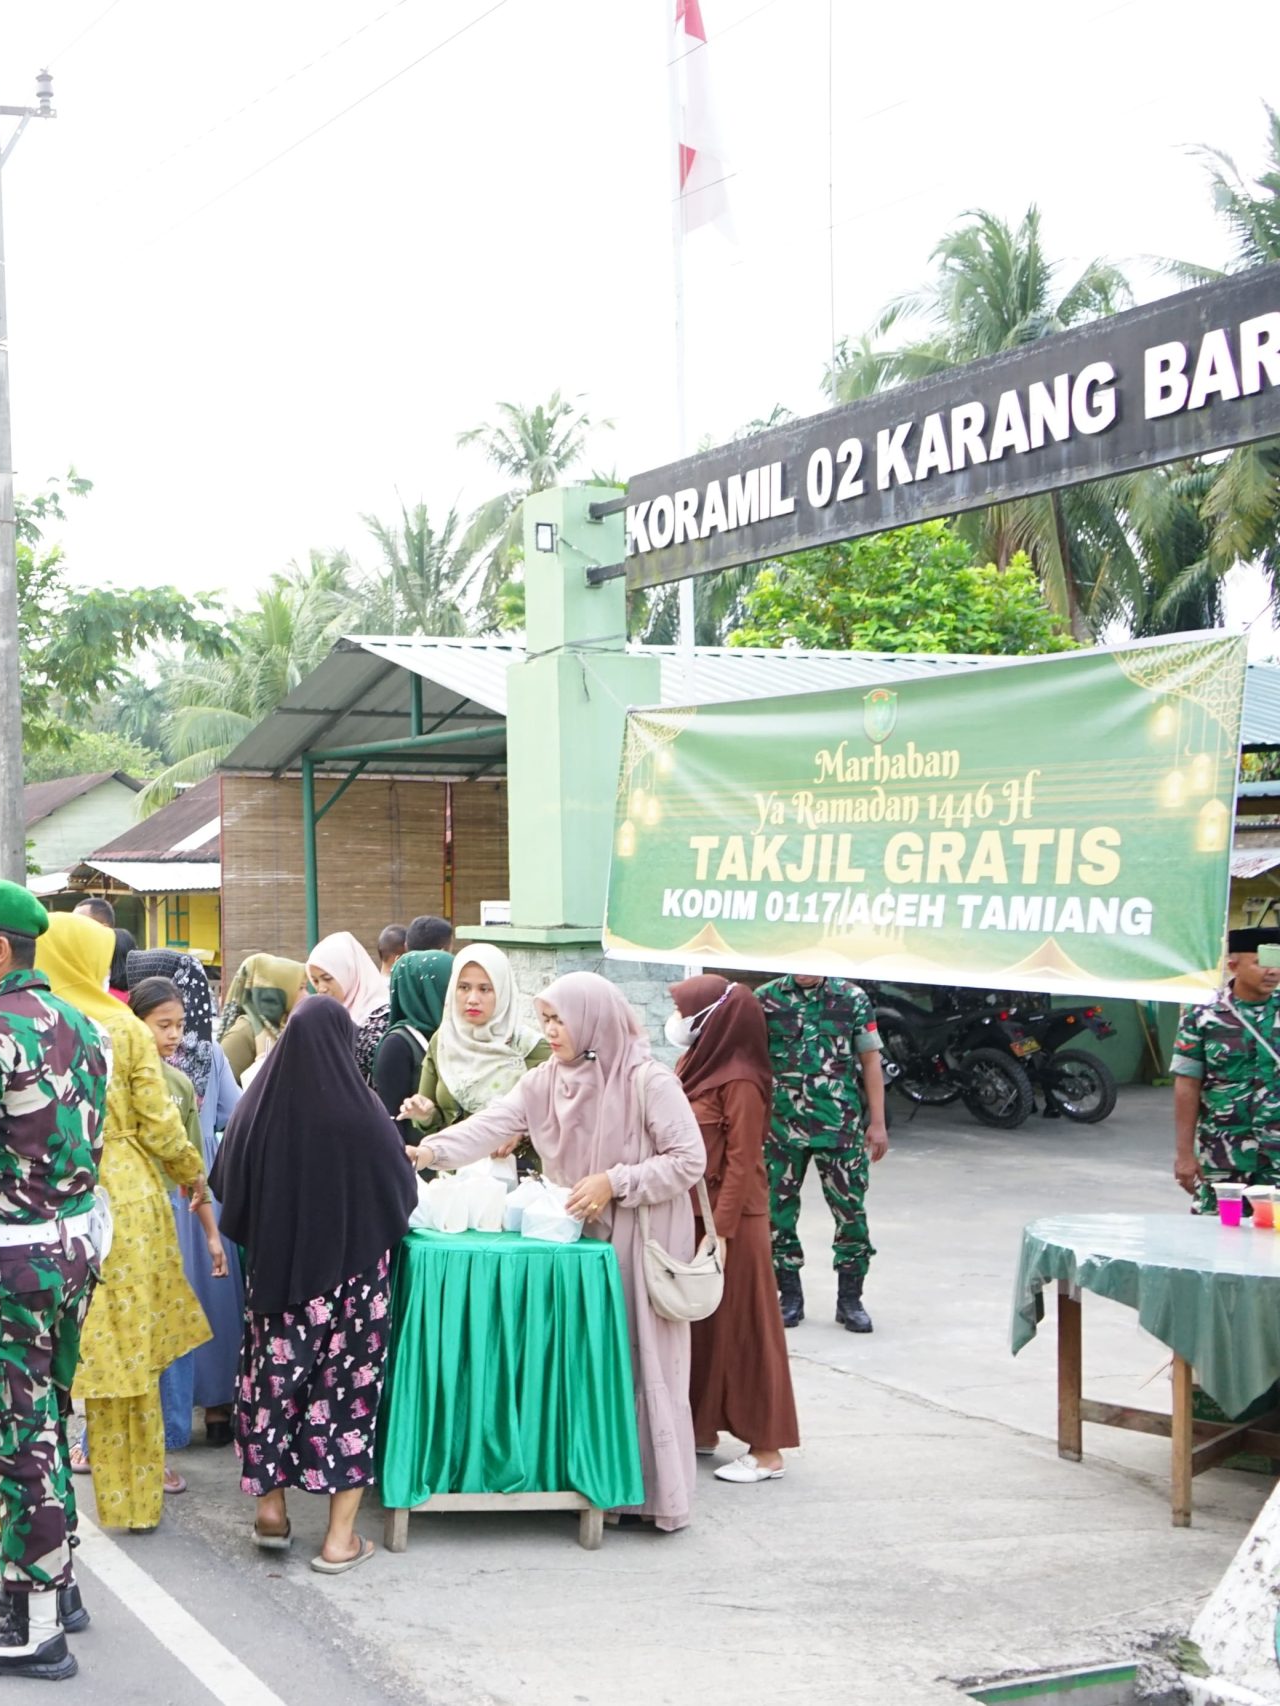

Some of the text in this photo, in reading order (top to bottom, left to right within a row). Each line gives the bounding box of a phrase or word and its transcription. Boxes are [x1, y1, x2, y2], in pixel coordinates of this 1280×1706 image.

[625, 461, 795, 556] KORAMIL
[806, 438, 863, 508] 02
[876, 361, 1116, 491] KARANG
[813, 741, 960, 784] Marhaban
[750, 769, 1041, 836] Ya Ramadan 1446 H
[689, 826, 1122, 886] TAKJIL GRATIS
[661, 885, 1153, 936] KODIM 0117/ACEH TAMIANG
